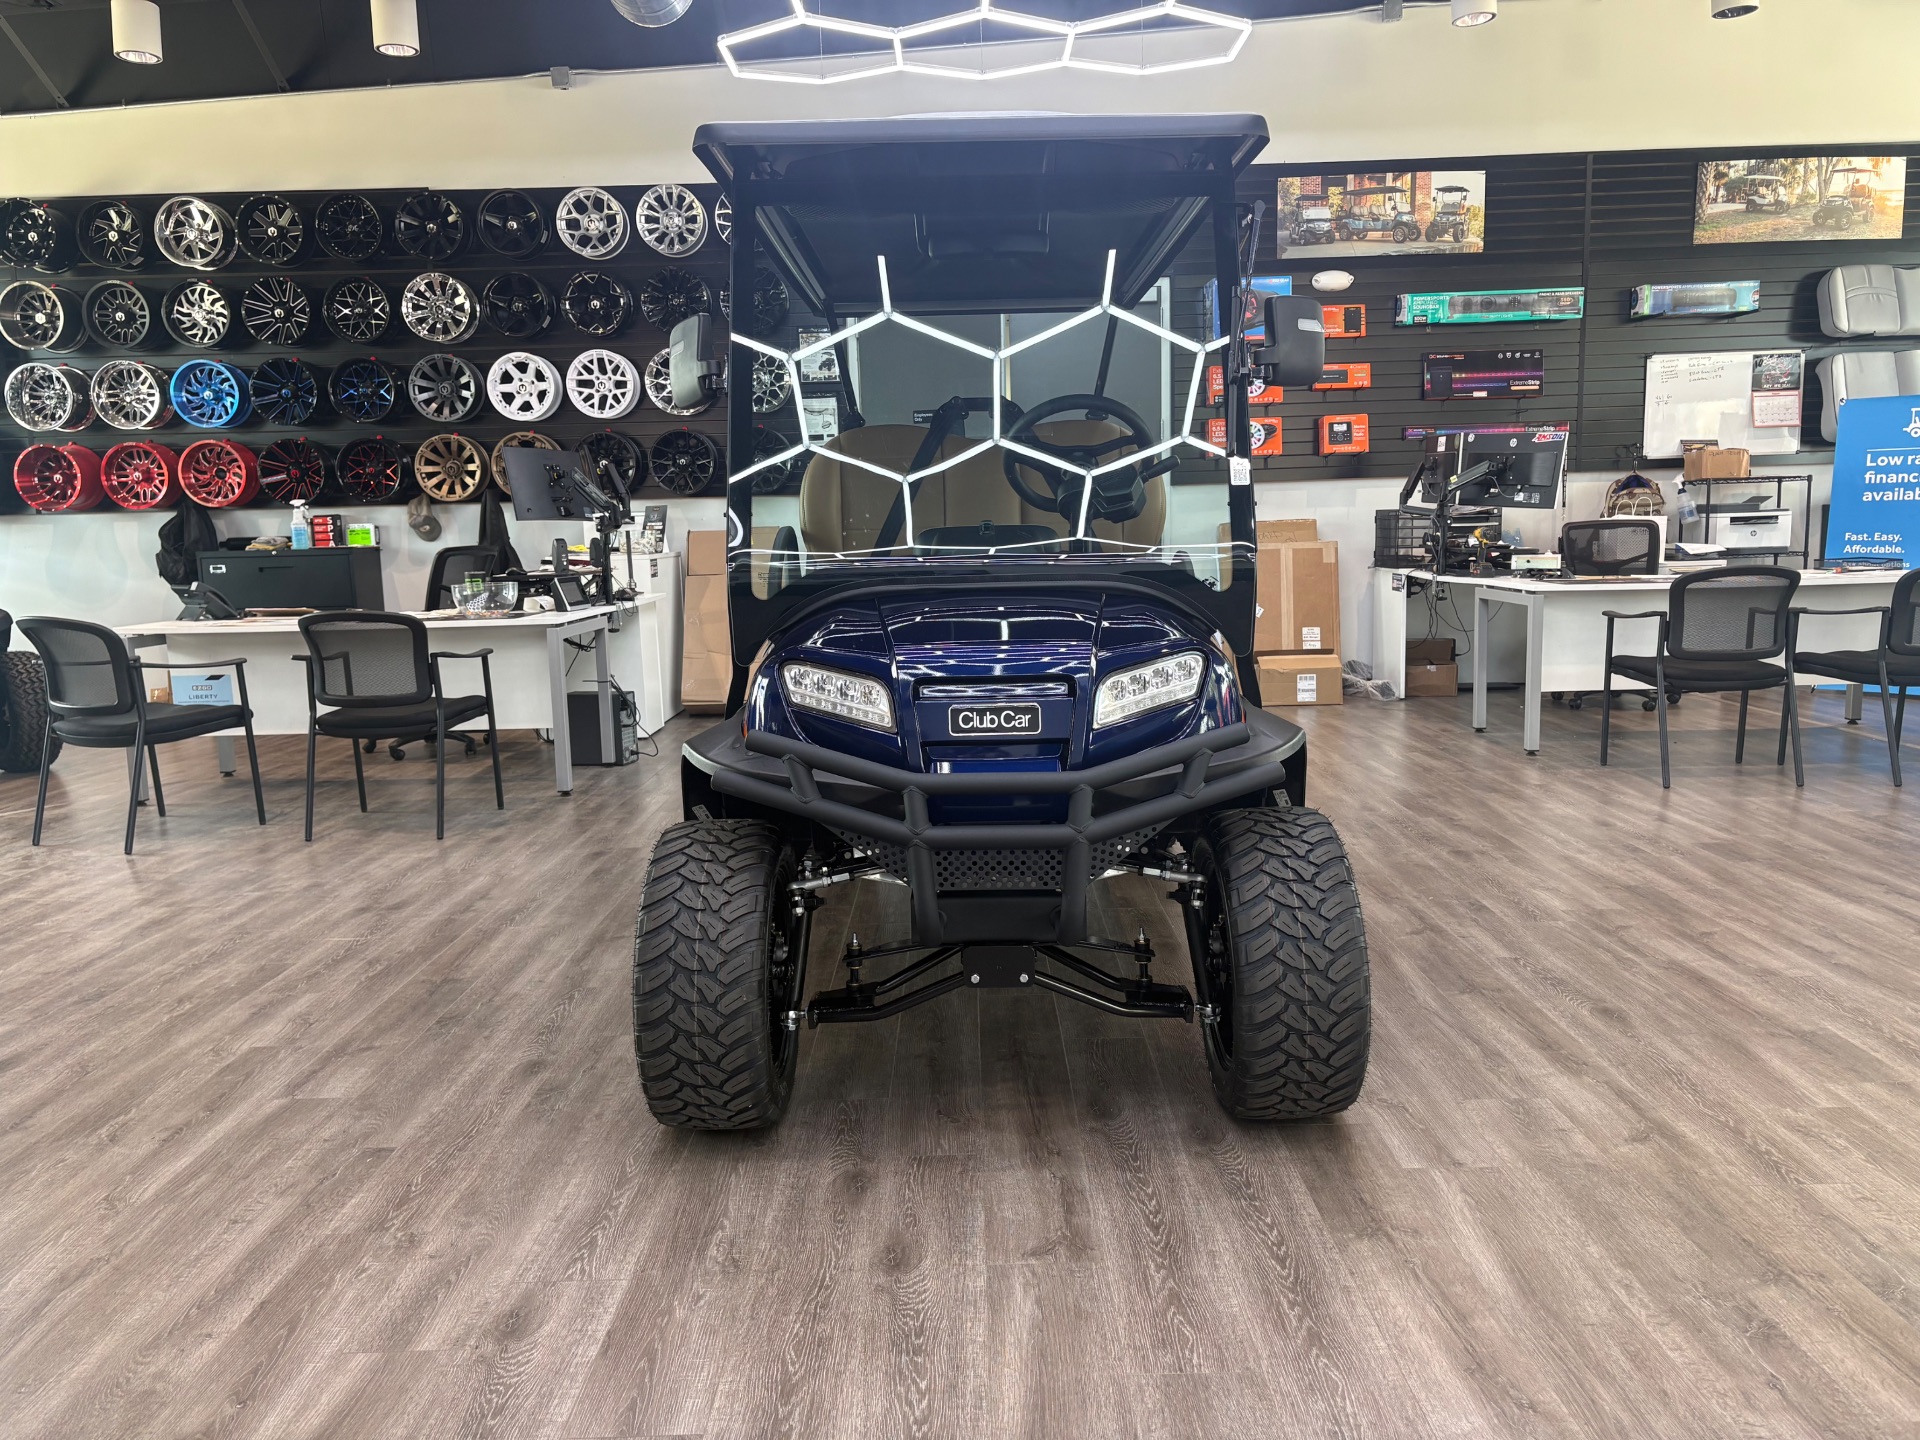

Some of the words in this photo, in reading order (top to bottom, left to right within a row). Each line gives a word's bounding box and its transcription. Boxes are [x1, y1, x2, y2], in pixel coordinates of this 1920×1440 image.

[1866, 453, 1904, 467] Low
[1864, 471, 1920, 484] financ
[1845, 532, 1871, 541] Fast.
[1874, 532, 1902, 543] Easy.
[1843, 545, 1905, 554] Affordable.
[958, 711, 999, 728] Club
[1000, 710, 1031, 728] Car
